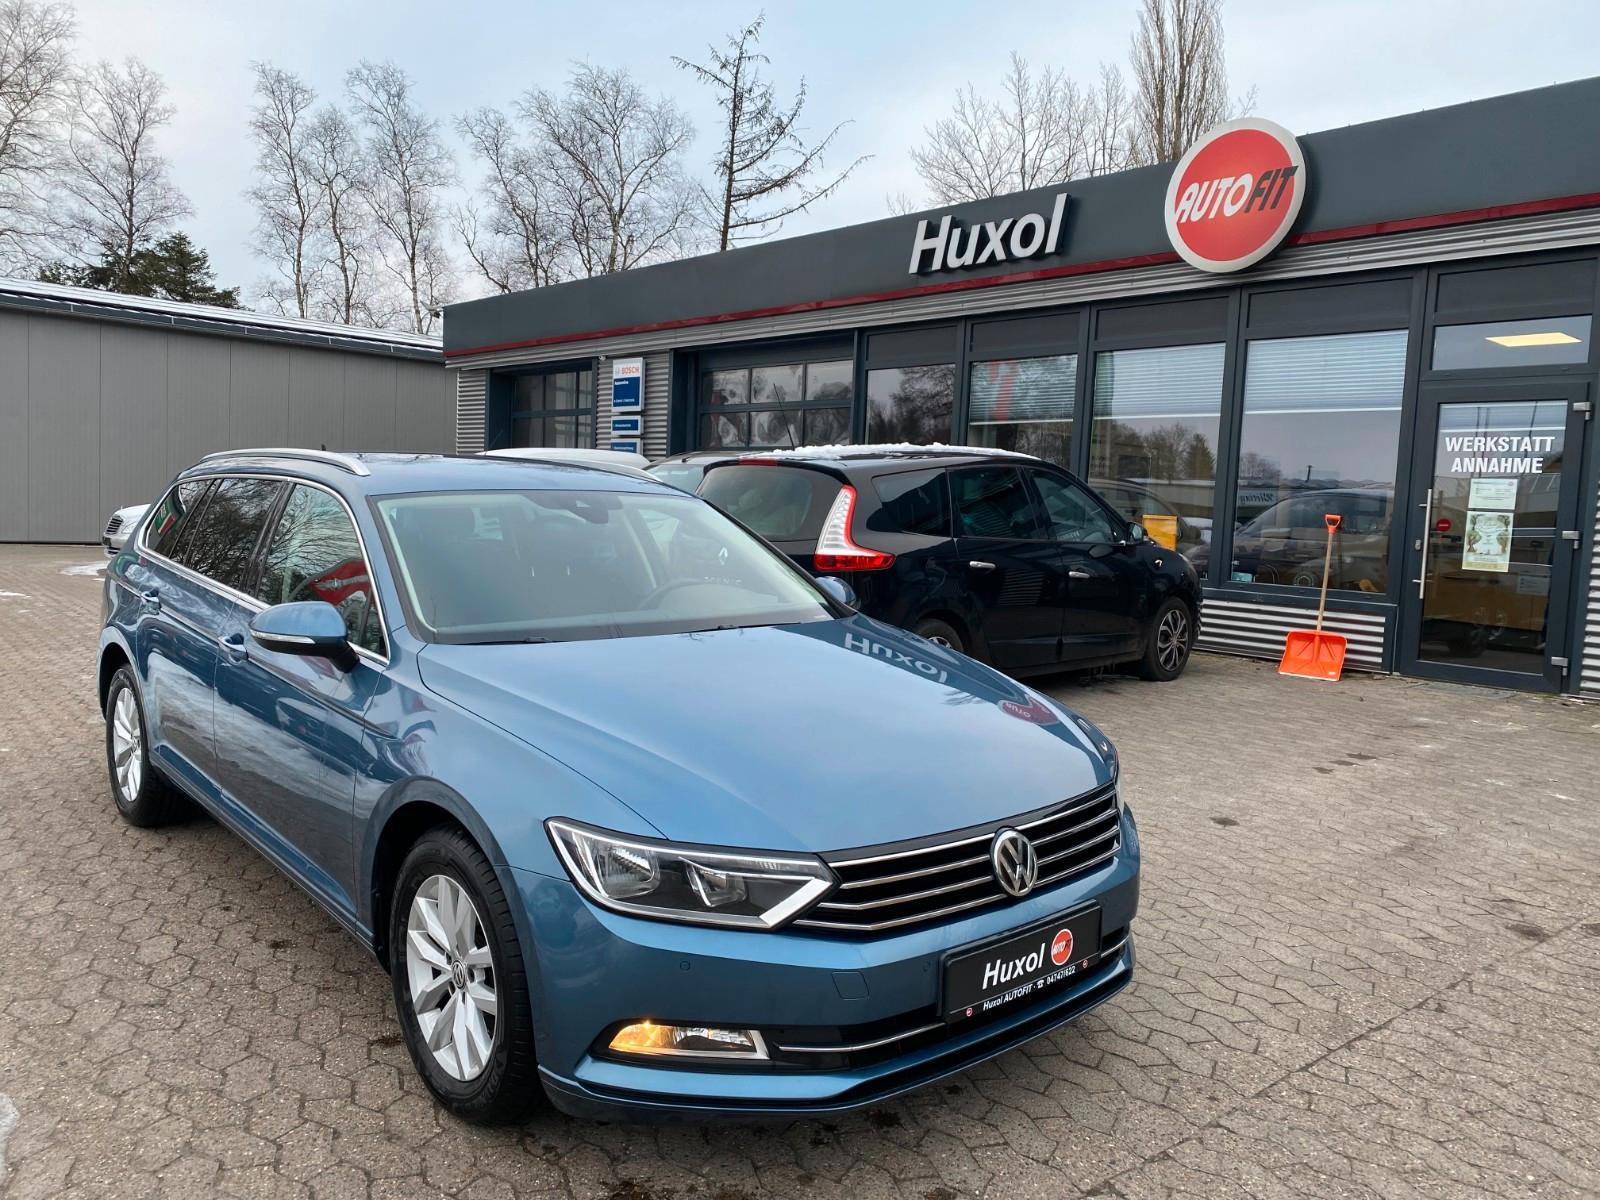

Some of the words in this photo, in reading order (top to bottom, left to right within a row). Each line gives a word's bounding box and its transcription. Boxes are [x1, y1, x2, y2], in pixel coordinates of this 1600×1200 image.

[1175, 165, 1299, 223] AUTOFIT
[908, 193, 1068, 274] Huxol
[621, 366, 640, 374] BOSCH
[1445, 436, 1556, 452] WERKSTATT
[1451, 457, 1544, 474] ANNAHME
[982, 942, 1046, 990] Huxol
[982, 995, 1003, 1011] Huxol
[1003, 983, 1033, 1004] AUTOFIT
